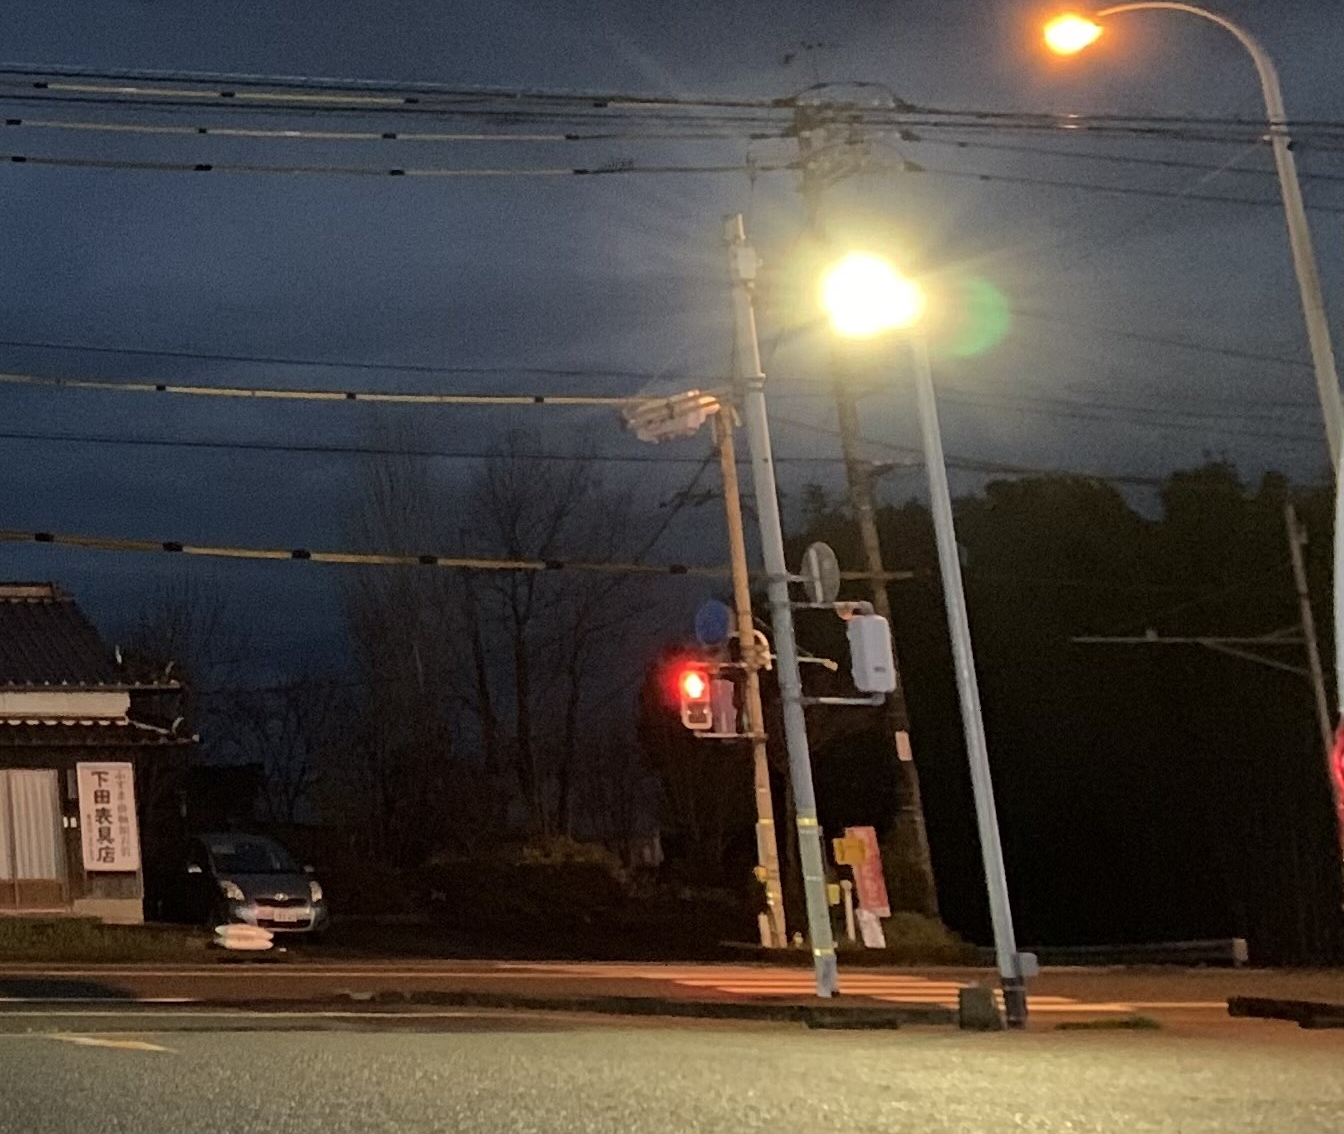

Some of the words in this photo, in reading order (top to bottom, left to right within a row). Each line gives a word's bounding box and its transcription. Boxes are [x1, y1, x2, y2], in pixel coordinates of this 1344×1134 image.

[90, 770, 116, 864] 下田表具店
